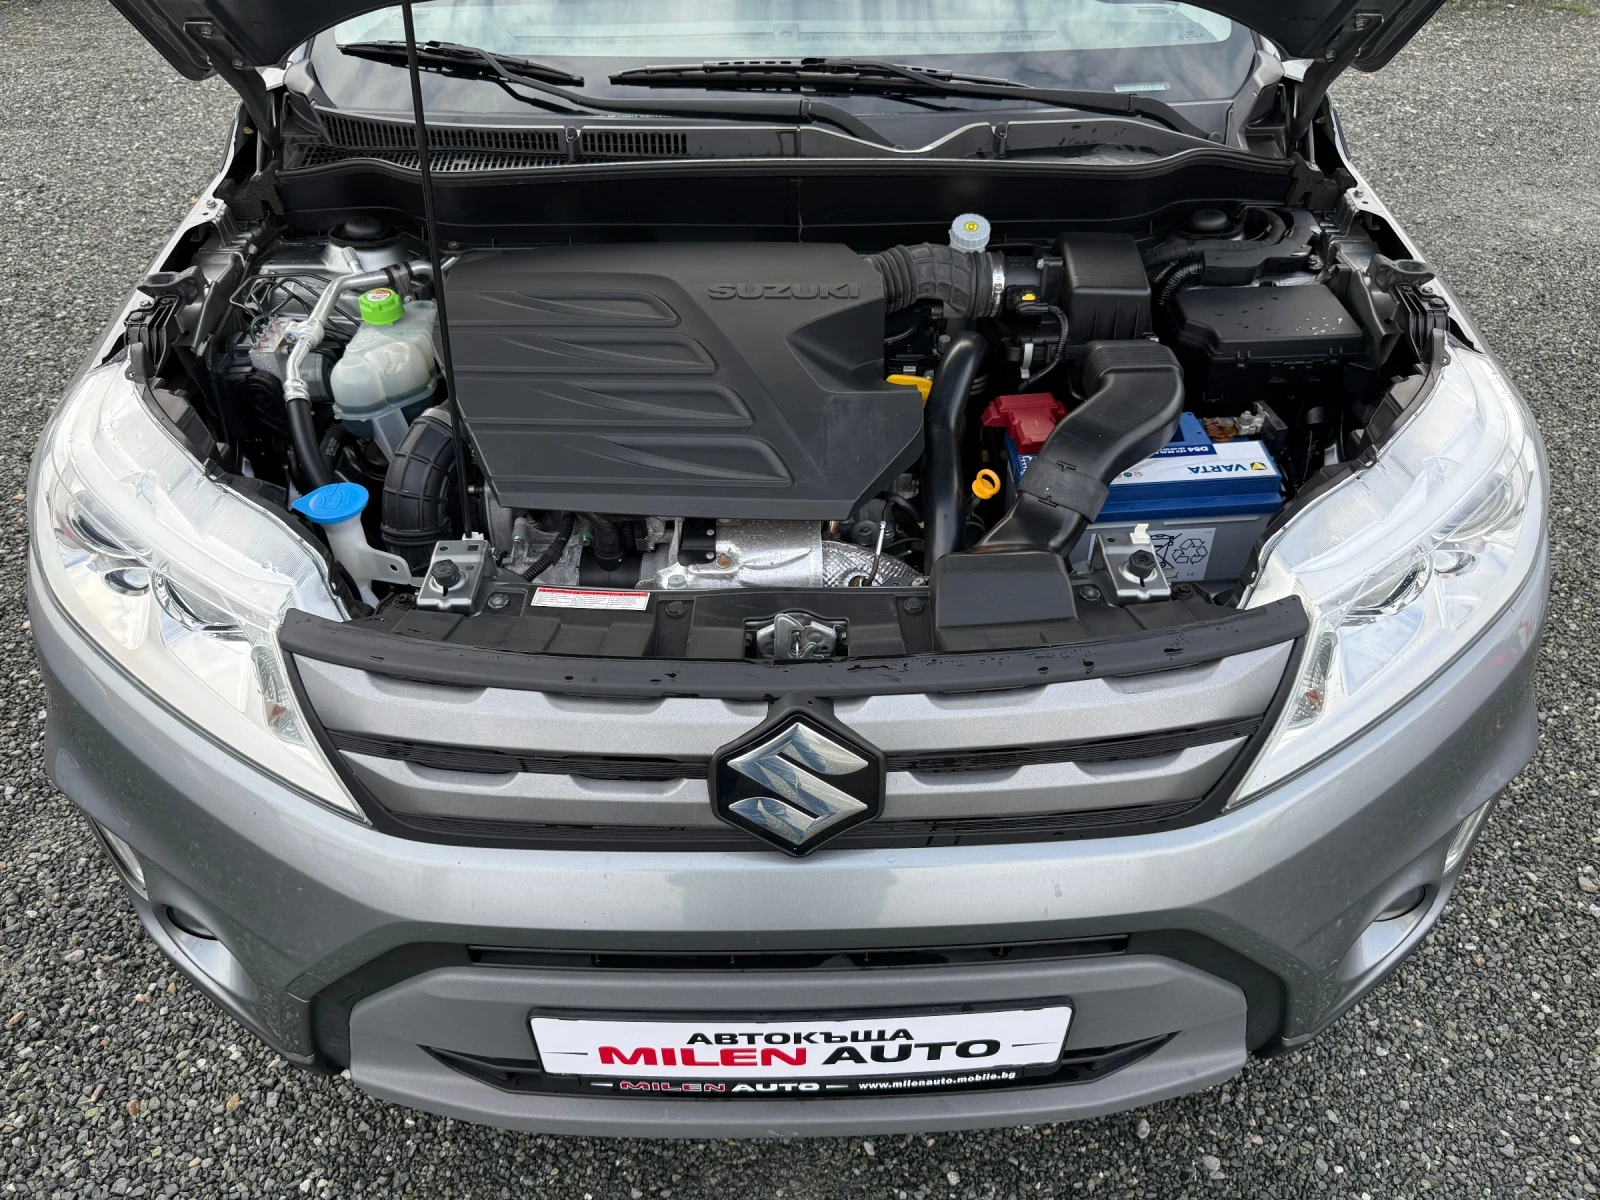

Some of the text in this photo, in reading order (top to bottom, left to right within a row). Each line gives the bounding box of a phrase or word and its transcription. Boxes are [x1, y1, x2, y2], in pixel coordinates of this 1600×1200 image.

[708, 283, 859, 300] SUZUKI
[1187, 463, 1247, 474] VARTA
[598, 1038, 1001, 1067] MILEN AUTO
[619, 1071, 1017, 1092] MILEN AUTO www.milenauto.mobile.bg
